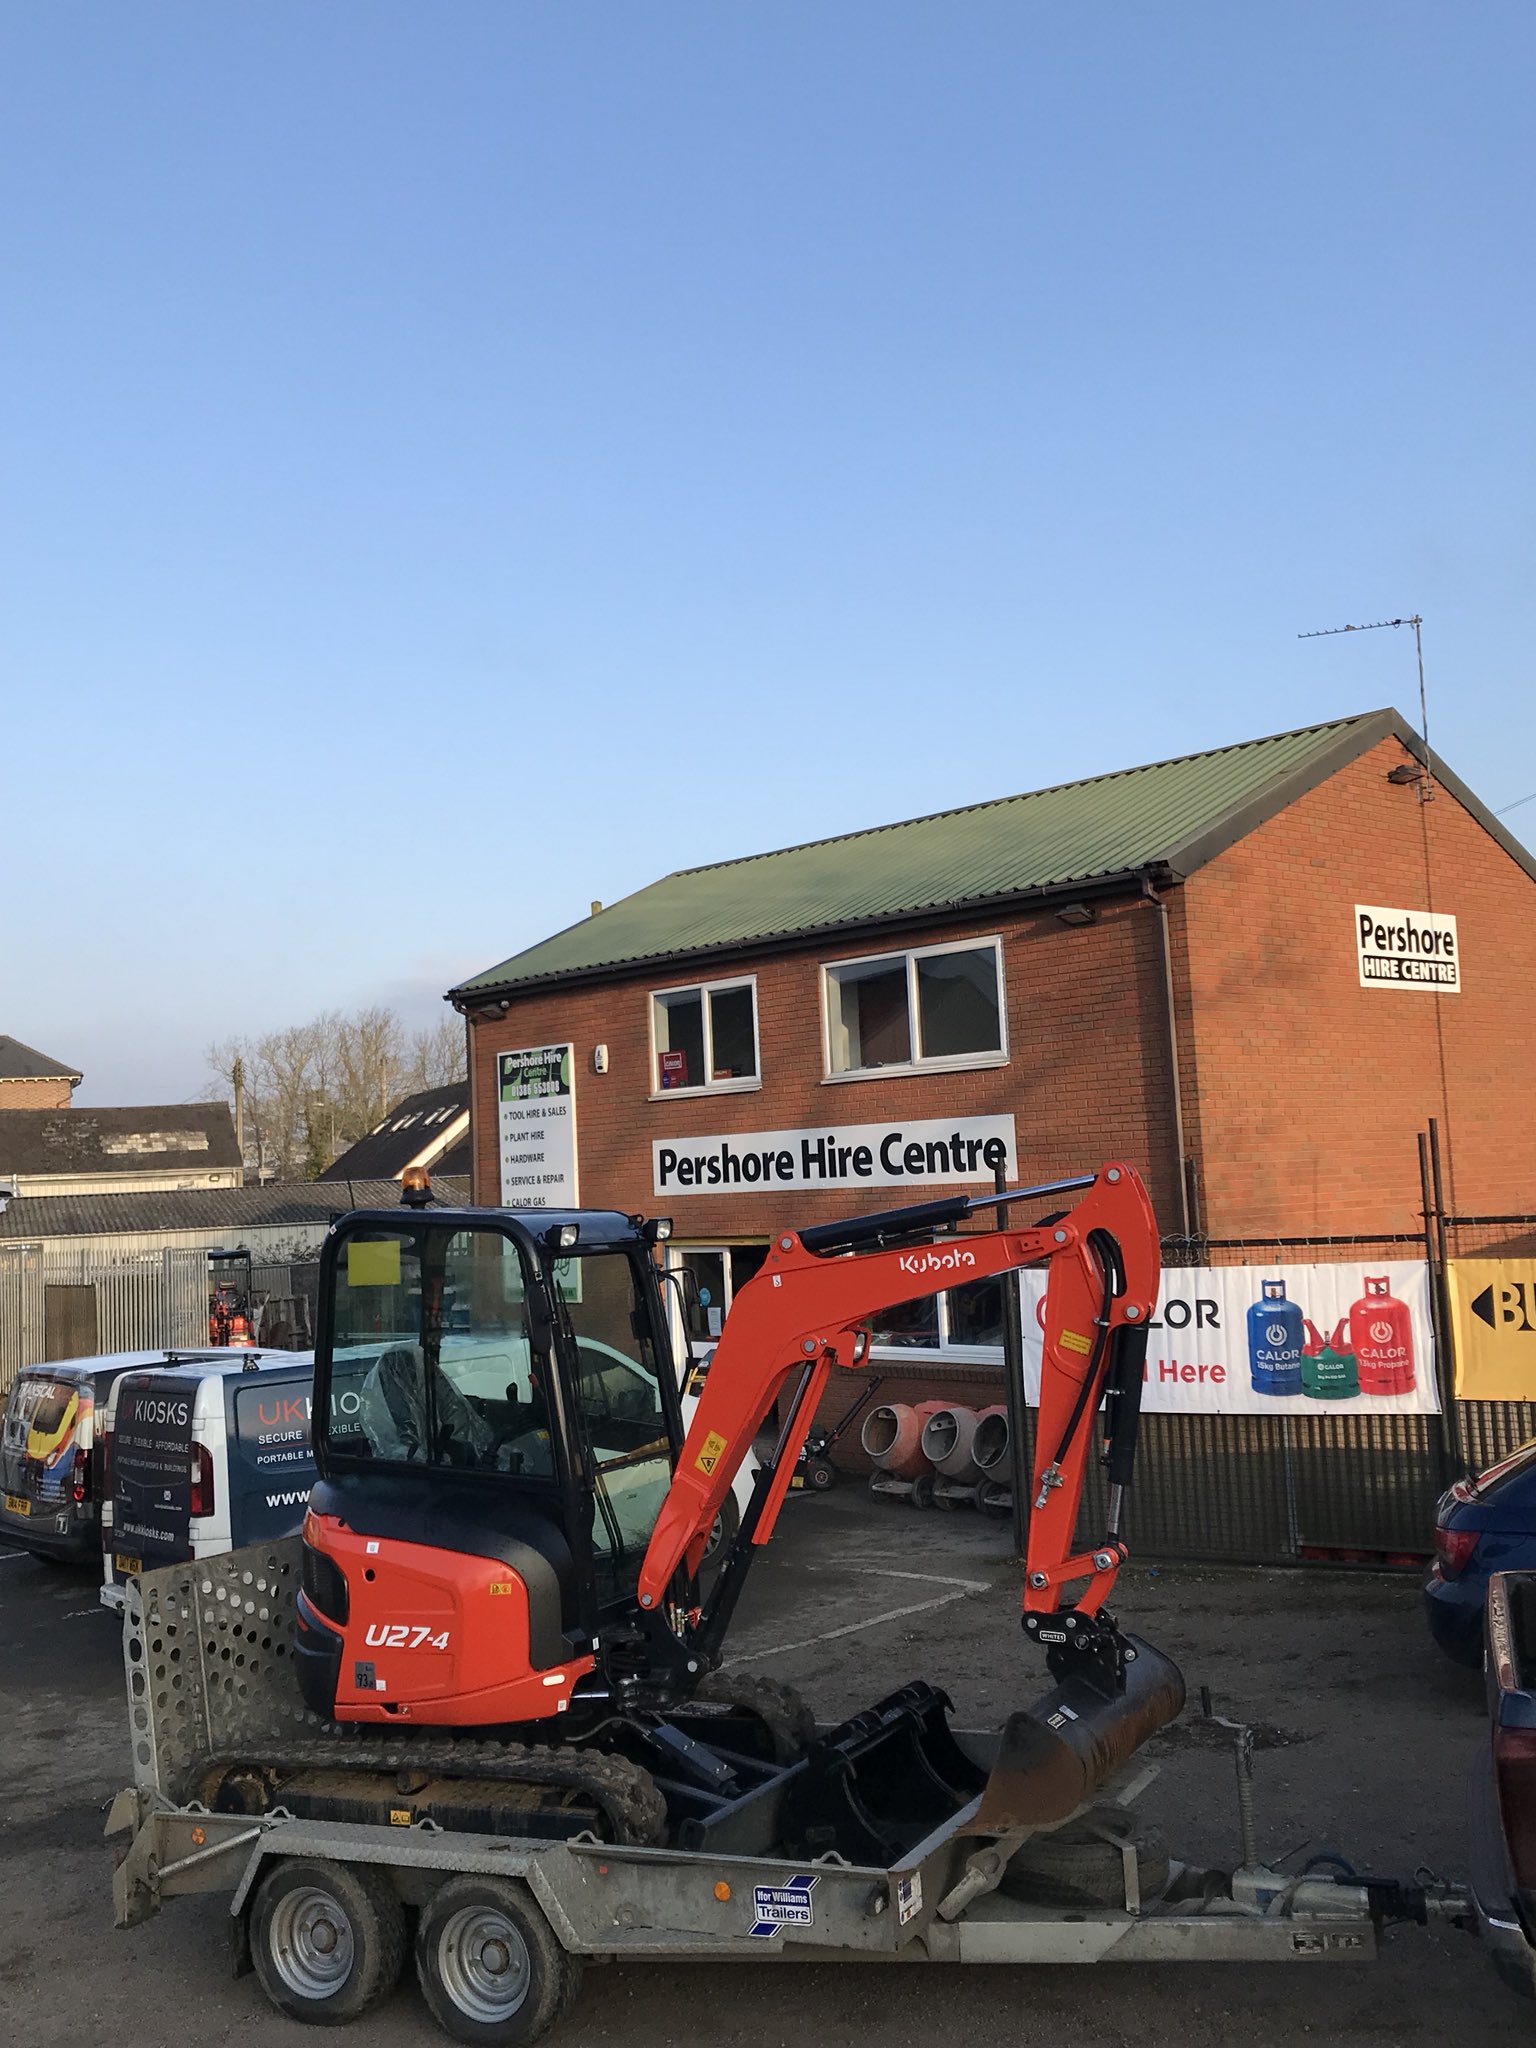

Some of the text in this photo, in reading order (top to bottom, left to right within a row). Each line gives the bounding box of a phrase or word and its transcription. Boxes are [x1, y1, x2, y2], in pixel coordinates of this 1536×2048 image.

[1360, 914, 1454, 956] Pershore
[1363, 957, 1456, 982] HIRE CENTRE
[507, 1051, 562, 1069] Pershore Hire
[523, 1067, 547, 1078] Centre
[509, 1106, 567, 1120] TOOL HIRE & SALES
[509, 1130, 545, 1142] PLANT HIRE
[510, 1152, 545, 1164] HARDWARE
[659, 1132, 1007, 1186] Pershore Hire Centre
[511, 1173, 565, 1186] SERVICE & REPAIR
[511, 1197, 546, 1208] CALOR GAS
[899, 1248, 976, 1274] Kubota
[1256, 1349, 1300, 1361] CALOR
[1360, 1346, 1407, 1359] CALOR
[1275, 1362, 1301, 1371] Butane
[1378, 1359, 1410, 1369] Propane
[1159, 1359, 1227, 1384] Here
[258, 1430, 303, 1445] SECURE
[155, 1440, 189, 1453] AFFORDABLE
[257, 1451, 304, 1465] PORTABLE
[365, 1624, 450, 1650] U27-4
[757, 1890, 808, 1904] Ifor Williams
[759, 1906, 809, 1920] Trailers
